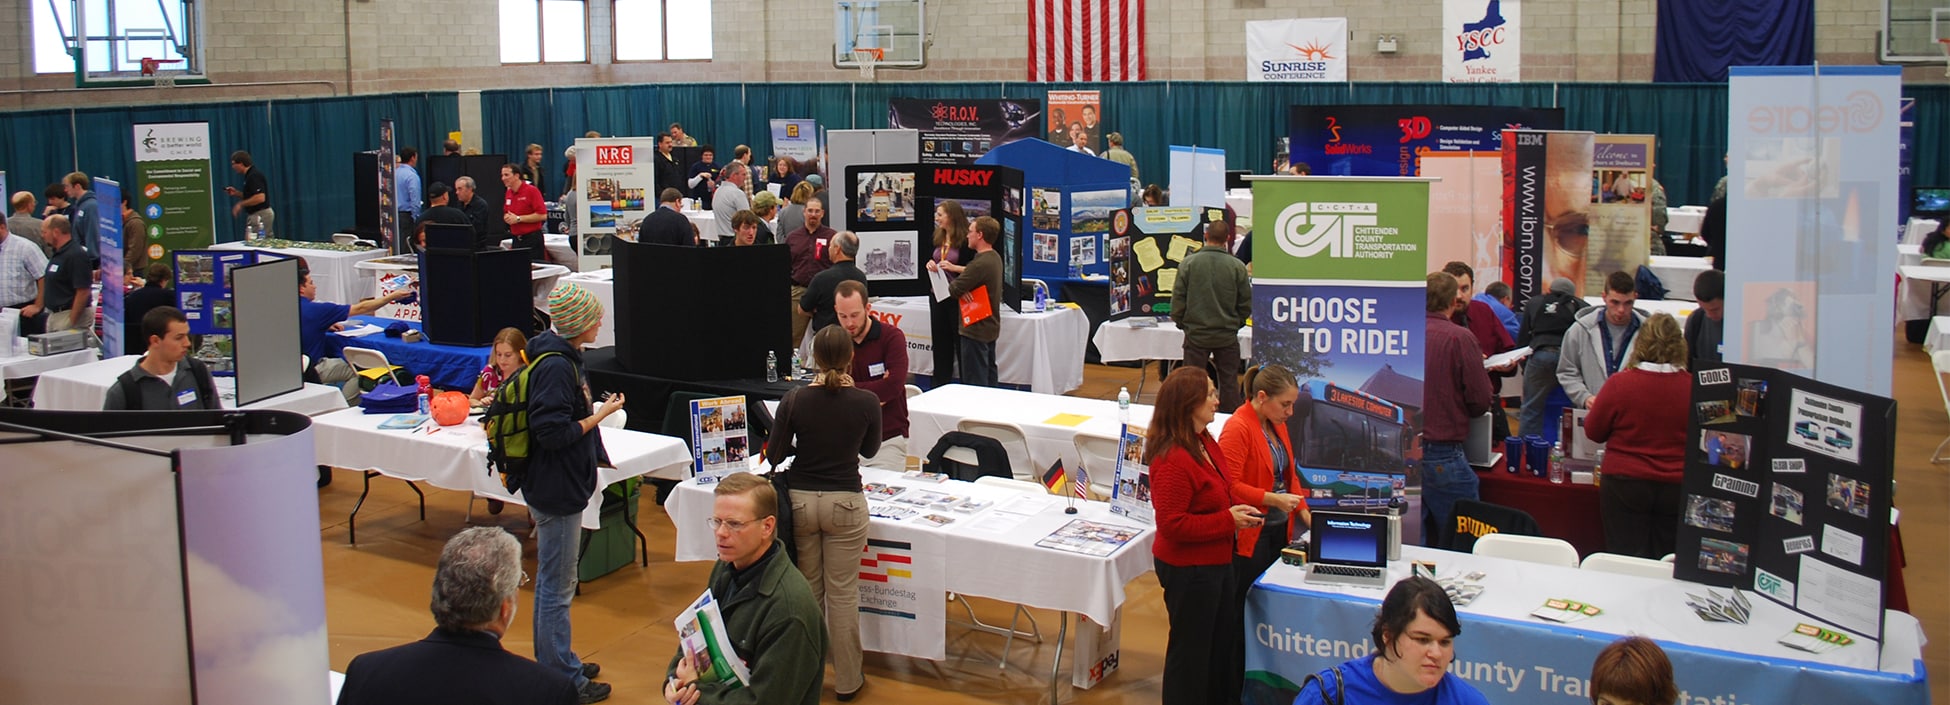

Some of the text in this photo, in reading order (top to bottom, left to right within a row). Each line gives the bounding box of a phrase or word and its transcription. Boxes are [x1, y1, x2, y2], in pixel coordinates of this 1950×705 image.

[1456, 27, 1505, 51] YSCC
[1262, 61, 1326, 72] SUNRISE
[1466, 65, 1496, 74] Yankee
[1264, 72, 1325, 80] CONFERENCE
[949, 106, 979, 121] R.O.V.
[1398, 116, 1431, 143] 3D
[1517, 134, 1543, 145] IBM
[599, 147, 630, 160] NRG
[1325, 144, 1372, 155] SolidWorks
[1595, 144, 1629, 159] elcome
[1400, 146, 1411, 176] esign
[934, 168, 994, 186] HUSKY
[1355, 227, 1398, 235] CHITTENDEN
[1355, 243, 1417, 251] TRANSPORTATION
[1355, 251, 1394, 259] AUTHORITY
[1272, 297, 1377, 324] CHOOSE
[869, 310, 902, 327] SKY
[1298, 327, 1408, 355] TO RIDE!
[1331, 389, 1392, 416] 3 LAKESIDE COMMUTER
[1312, 474, 1327, 482] 910
[858, 585, 916, 600] ess-Bundestag
[861, 594, 897, 608] Exchange
